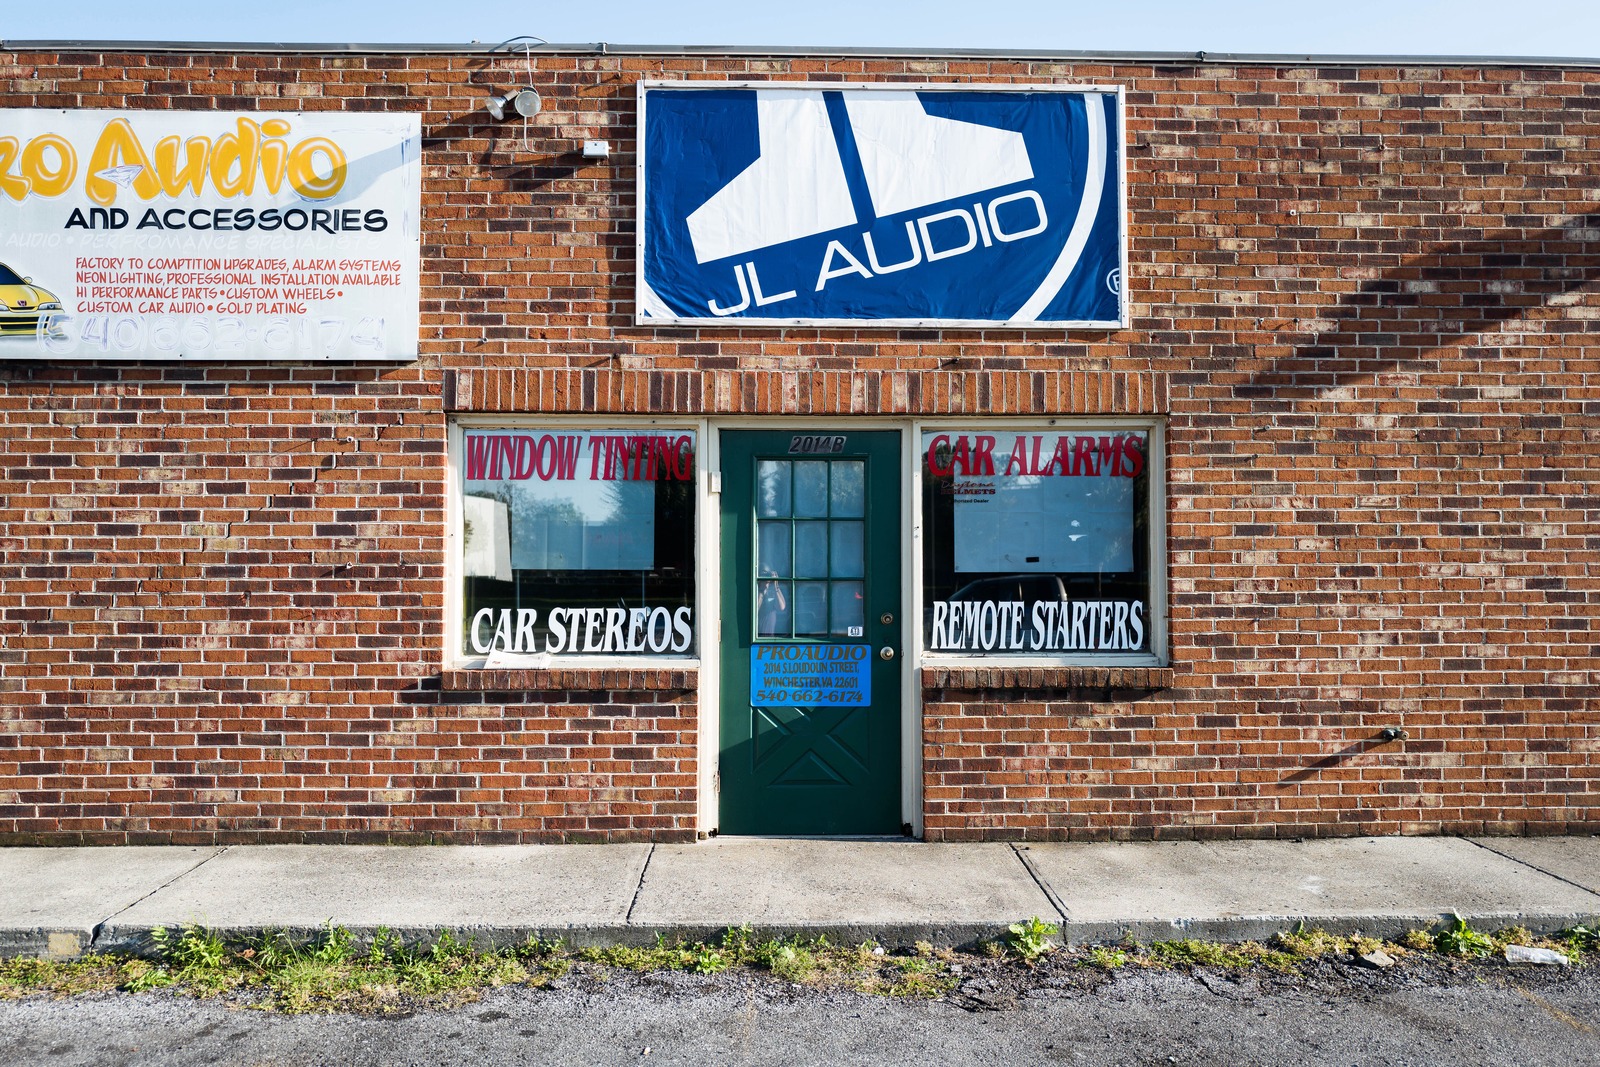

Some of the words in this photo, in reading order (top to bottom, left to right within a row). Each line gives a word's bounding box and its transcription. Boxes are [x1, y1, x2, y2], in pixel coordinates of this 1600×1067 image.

[85, 117, 347, 206] Audio
[136, 208, 388, 234] ACCESSORIES
[4, 232, 61, 248] AUDIO
[245, 233, 383, 250] SPECIALISTS
[708, 261, 797, 316] JL
[815, 189, 1048, 292] AUDIO
[75, 257, 125, 269] FACTORY
[128, 258, 143, 269] TO
[147, 258, 221, 270] COMPTITION
[224, 258, 289, 273] UPGRADES,
[292, 259, 336, 271] ALARM
[339, 259, 402, 272] SYSTEMS
[76, 271, 107, 284] NEON
[167, 272, 256, 285] PROFESSIONAL
[261, 273, 339, 286] INSTALLATION
[342, 273, 401, 286] AVAILABLE
[76, 287, 87, 298] HI
[92, 287, 178, 299] PERFORMANCE
[282, 288, 336, 300] WHEELS
[77, 301, 133, 313] CUSTOM
[138, 301, 164, 314] CAR
[216, 302, 253, 314] GOLD
[256, 302, 307, 315] PLATING
[789, 436, 845, 453] 2014B
[466, 434, 583, 481] WINDOW
[588, 434, 694, 481] TINTING
[927, 434, 997, 477] CAR
[1004, 435, 1144, 478] ALARMS
[470, 607, 537, 653] CAR
[546, 606, 692, 654] STEREOS
[930, 600, 1026, 650] REMOTE
[1030, 600, 1144, 651] STARTERS
[763, 662, 781, 674] 2014
[834, 676, 859, 689] 22601
[756, 689, 863, 703] 540-662-6174
